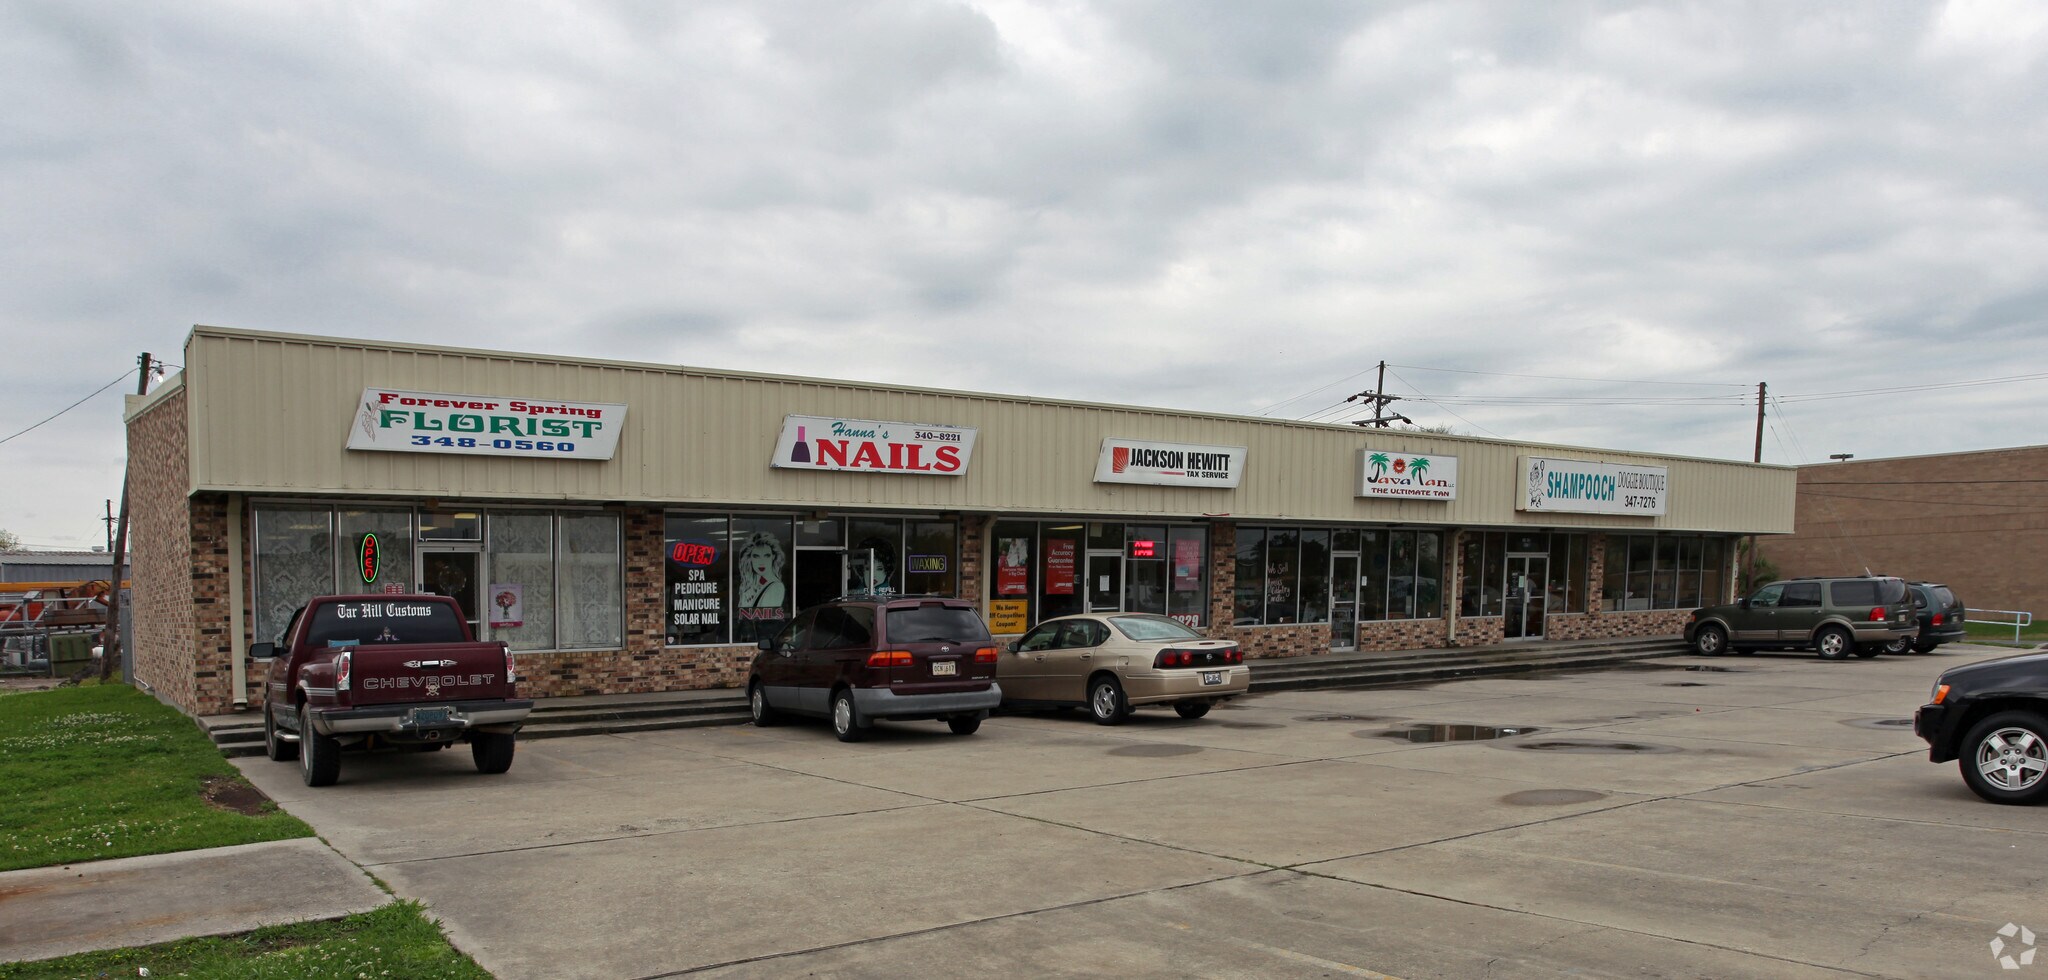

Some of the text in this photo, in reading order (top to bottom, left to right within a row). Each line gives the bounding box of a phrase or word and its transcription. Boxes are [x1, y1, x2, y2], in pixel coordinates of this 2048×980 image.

[379, 393, 602, 418] Forever Spring
[379, 410, 602, 438] FLORIST
[831, 422, 889, 439] Hanna's
[411, 435, 575, 452] 348-0560
[915, 431, 961, 442] 340-8221
[815, 438, 961, 472] NAILS
[1130, 448, 1230, 471] JACKSON HEWITT
[1186, 470, 1228, 479] TAX SERVICE
[1547, 471, 1616, 501] SHAMPOOCH
[1618, 471, 1664, 494] DOGGIE BOUTIQUE
[1390, 488, 1431, 496] ULTIMATE
[1625, 495, 1656, 509] 347-7276
[673, 542, 715, 565] OPEN
[911, 557, 944, 571] WAXING
[688, 569, 705, 581] SPA
[675, 582, 717, 594] PEDICURE
[361, 604, 382, 618] Hill
[386, 603, 432, 618] Customs
[674, 598, 720, 611] MANICURE
[674, 613, 720, 625] SOLAR NAIL
[738, 607, 785, 620] NAILS
[363, 674, 495, 690] CHEVROLET
